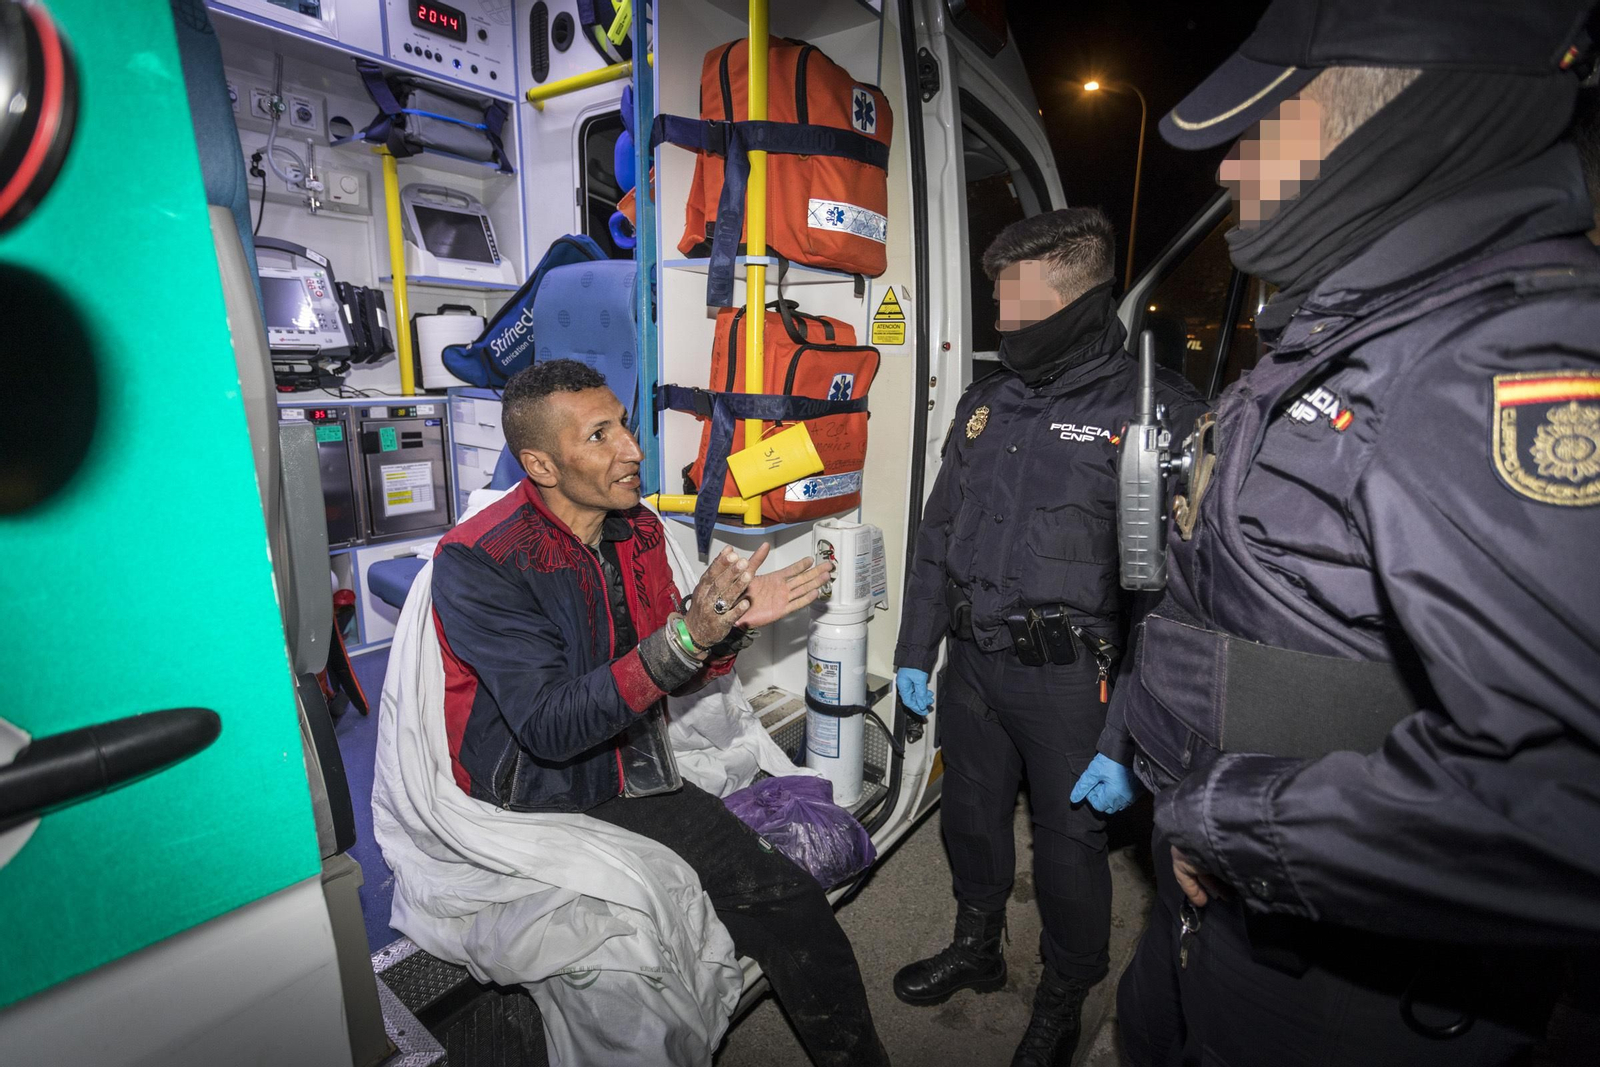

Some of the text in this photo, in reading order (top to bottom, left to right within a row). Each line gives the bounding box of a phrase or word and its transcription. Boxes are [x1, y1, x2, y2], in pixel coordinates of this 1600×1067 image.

[418, 6, 458, 30] 2044
[501, 341, 530, 367] Extrication
[314, 410, 326, 420] 35
[1286, 400, 1318, 422] NP
[1050, 423, 1111, 440] POLICIA
[1060, 432, 1095, 442] CNP
